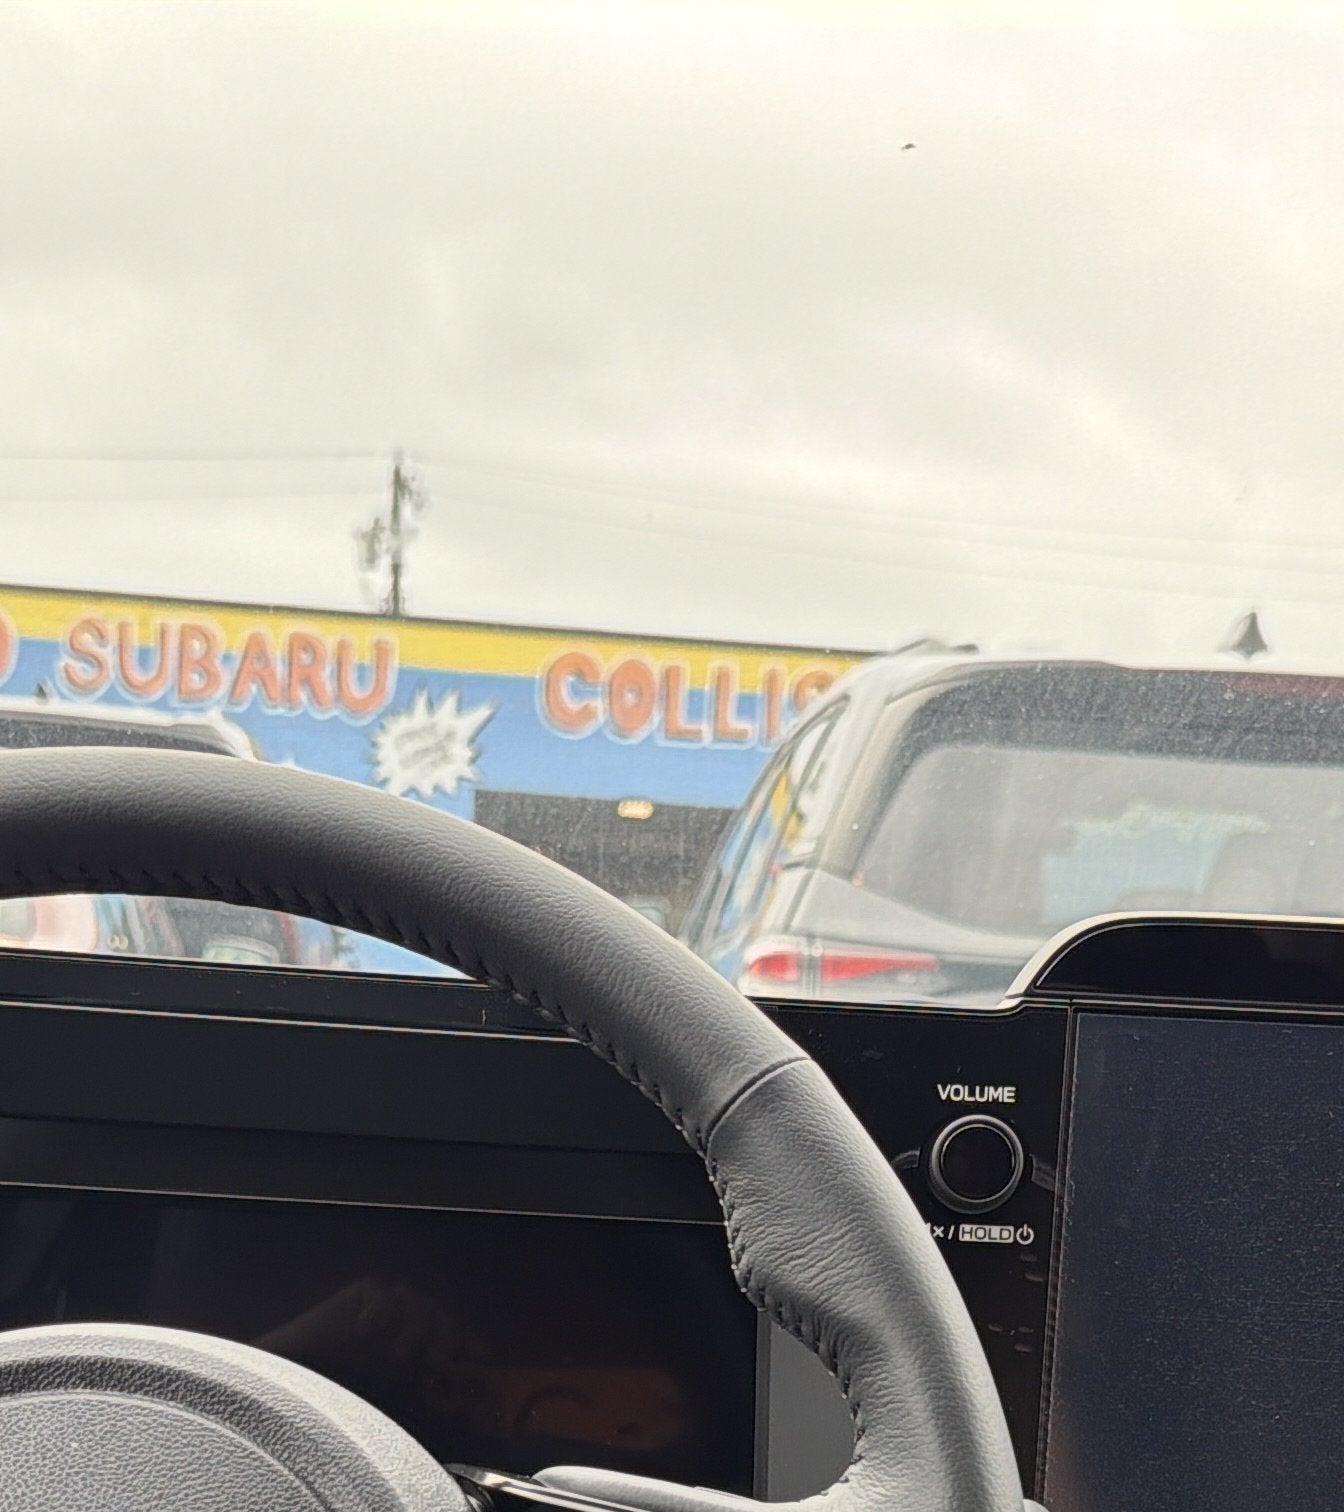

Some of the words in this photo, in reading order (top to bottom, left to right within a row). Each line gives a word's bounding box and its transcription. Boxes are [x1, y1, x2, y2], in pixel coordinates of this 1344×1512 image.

[62, 617, 393, 714] SUBARU
[937, 1084, 1016, 1103] VOLUME
[960, 1225, 1013, 1242] HOLD
